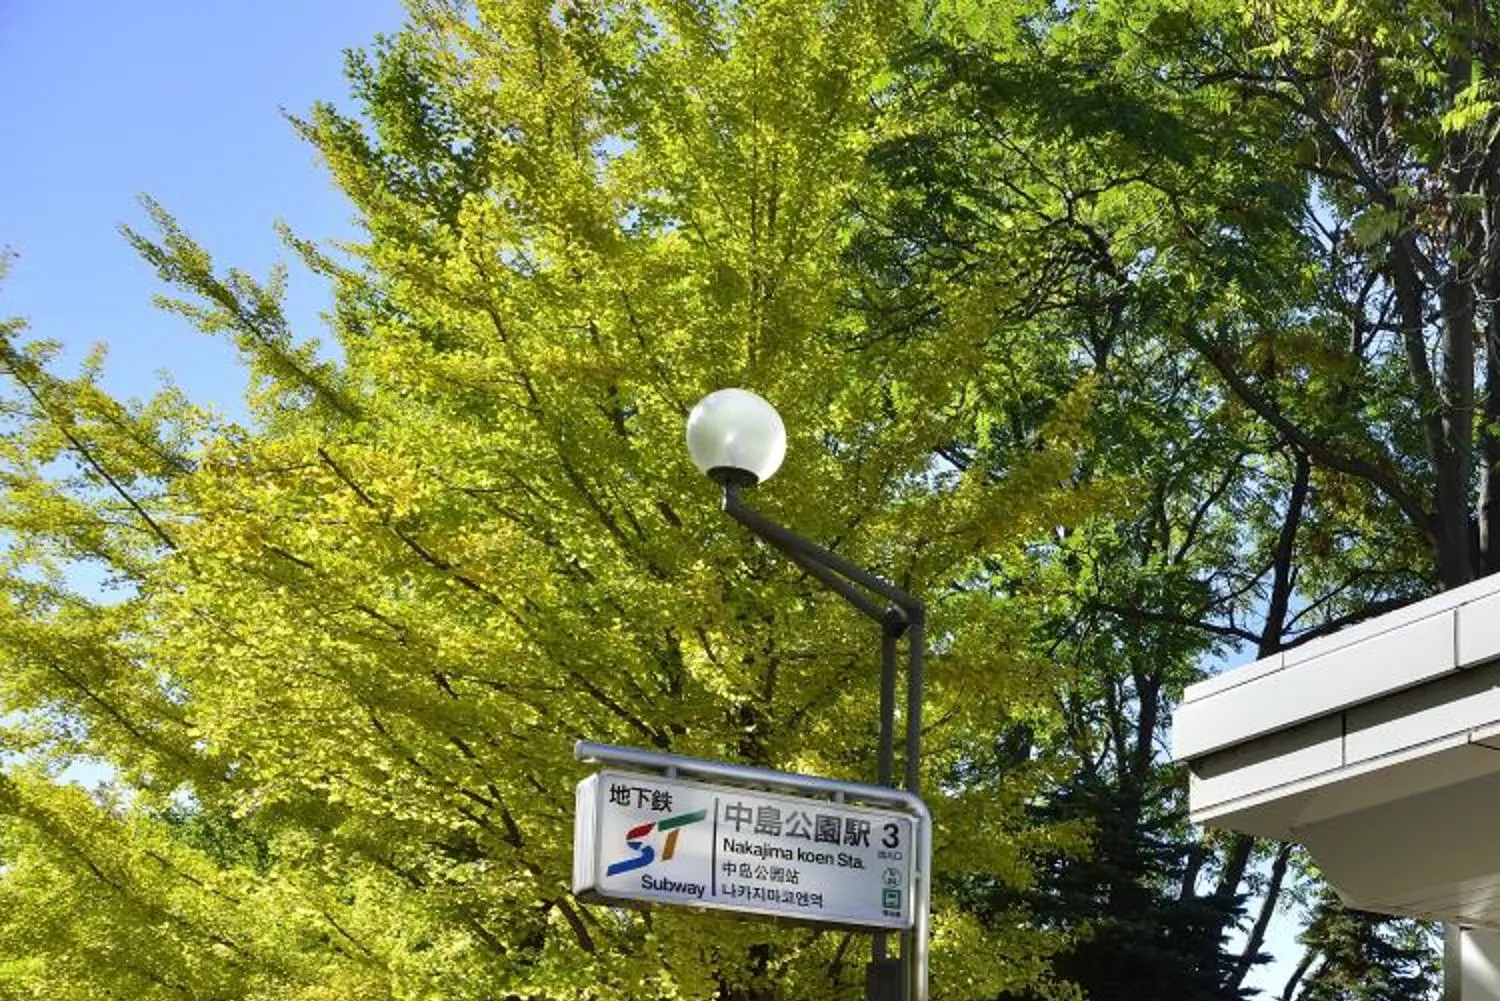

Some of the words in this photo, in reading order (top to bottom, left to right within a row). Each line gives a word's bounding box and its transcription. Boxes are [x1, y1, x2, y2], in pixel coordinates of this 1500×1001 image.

[608, 784, 673, 813] 地下鉄
[725, 801, 872, 848] 中島公園駅
[881, 823, 900, 849] 3
[722, 837, 793, 861] Nakajima
[797, 847, 835, 866] koen
[837, 853, 866, 870] Sta.
[641, 873, 706, 899] Subway
